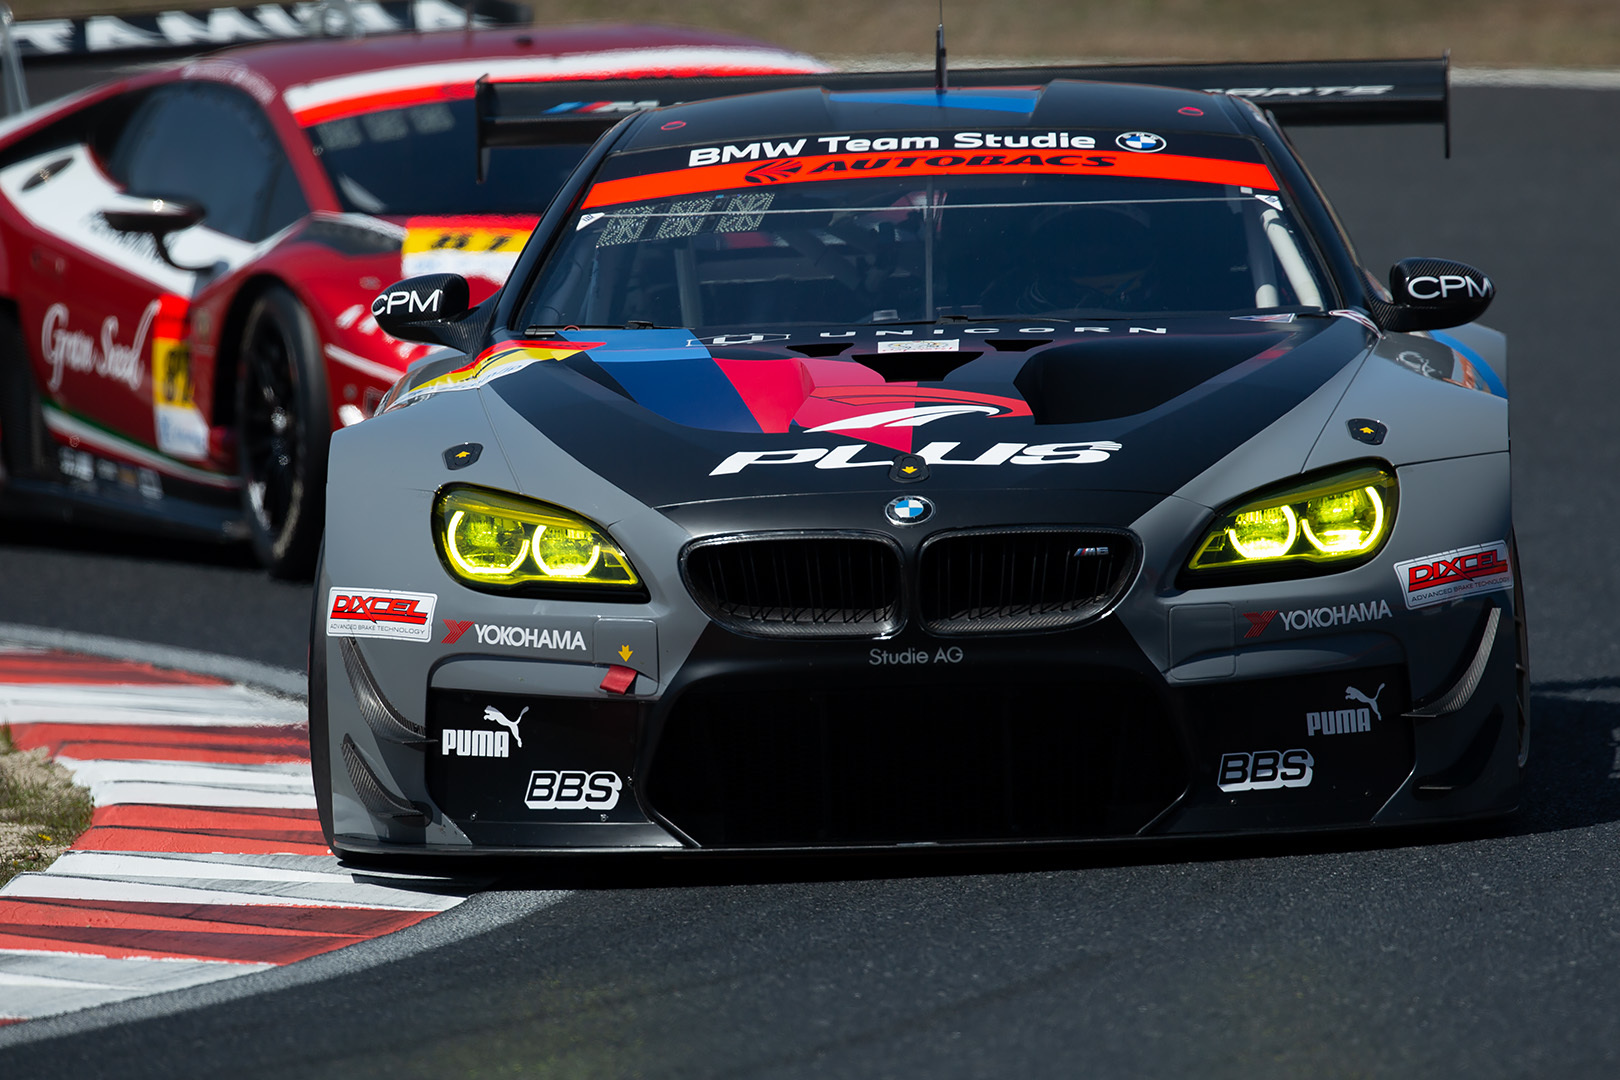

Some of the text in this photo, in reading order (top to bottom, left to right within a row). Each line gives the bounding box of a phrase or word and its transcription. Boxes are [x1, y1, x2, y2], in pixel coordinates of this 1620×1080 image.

[688, 132, 1097, 168] BMW Team Studie
[806, 155, 1117, 176] AUTOBACS
[1407, 275, 1494, 300] CPM
[371, 289, 443, 317] CPM
[819, 326, 1167, 338] UNICORN
[709, 440, 1123, 476] PLUS
[1408, 549, 1508, 584] DIXCEL
[1411, 576, 1510, 602] ADVANCED BRAKE TECHNOLOGY
[331, 594, 429, 623] DIXCEL
[1279, 599, 1393, 631] YOKOHAMA
[330, 622, 357, 631] ADVANCED
[377, 625, 426, 635] TECHNOLOGY
[475, 623, 587, 651] YOKOHAMA
[868, 646, 964, 666] Studie AG
[1306, 708, 1371, 737] PUMA
[442, 728, 509, 758] PUMA
[1217, 748, 1314, 792] BBS
[524, 770, 622, 810] BBS
